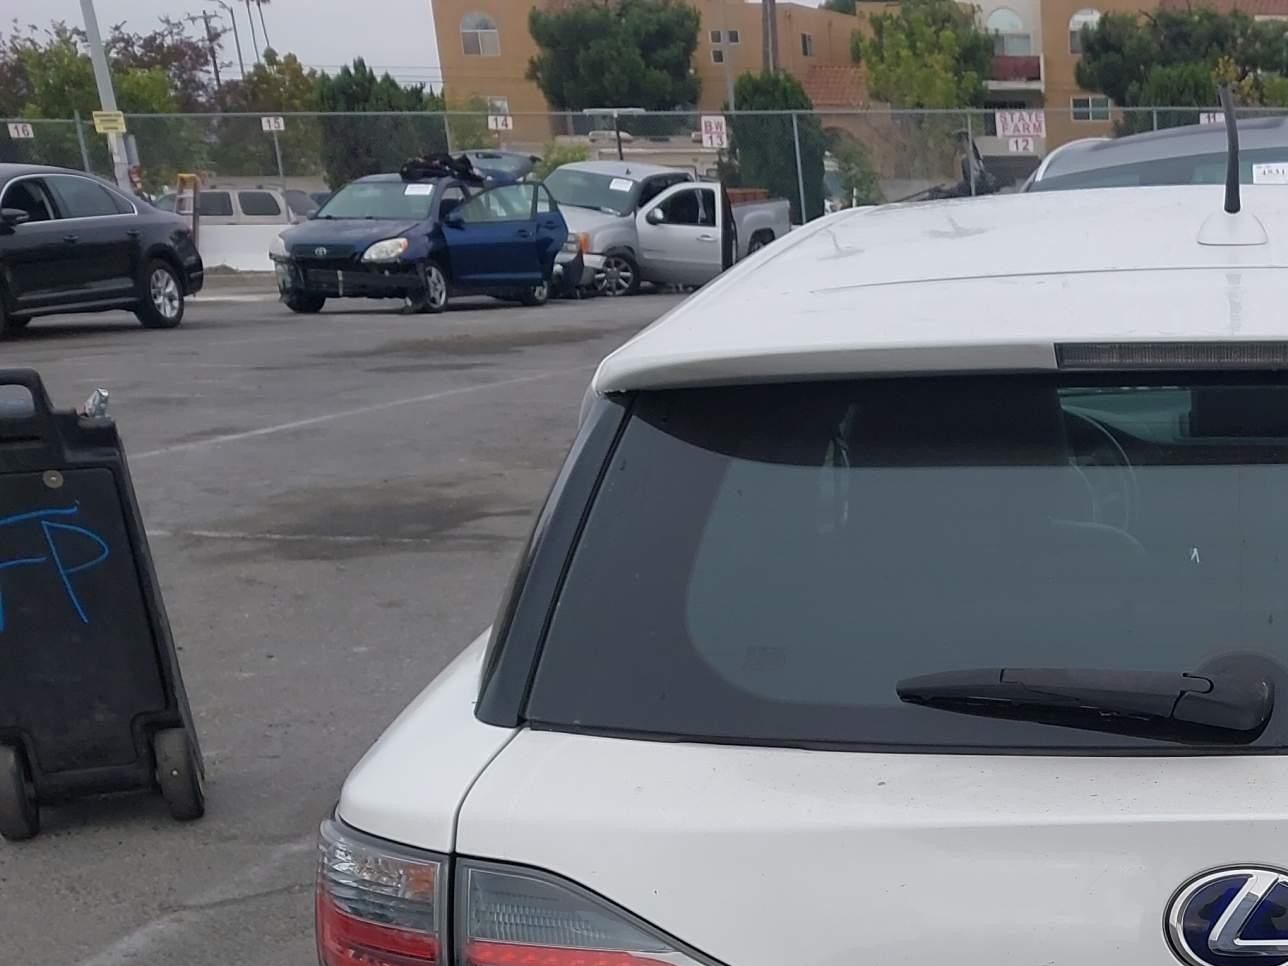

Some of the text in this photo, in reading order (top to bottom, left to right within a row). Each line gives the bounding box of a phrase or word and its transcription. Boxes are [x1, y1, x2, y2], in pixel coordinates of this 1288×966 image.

[267, 116, 282, 129] 15
[493, 115, 509, 128] 14
[1000, 111, 1043, 122] STATE
[13, 124, 30, 137] 16
[1002, 122, 1042, 133] FARM
[709, 134, 724, 146] 13
[1014, 139, 1030, 151] 12
